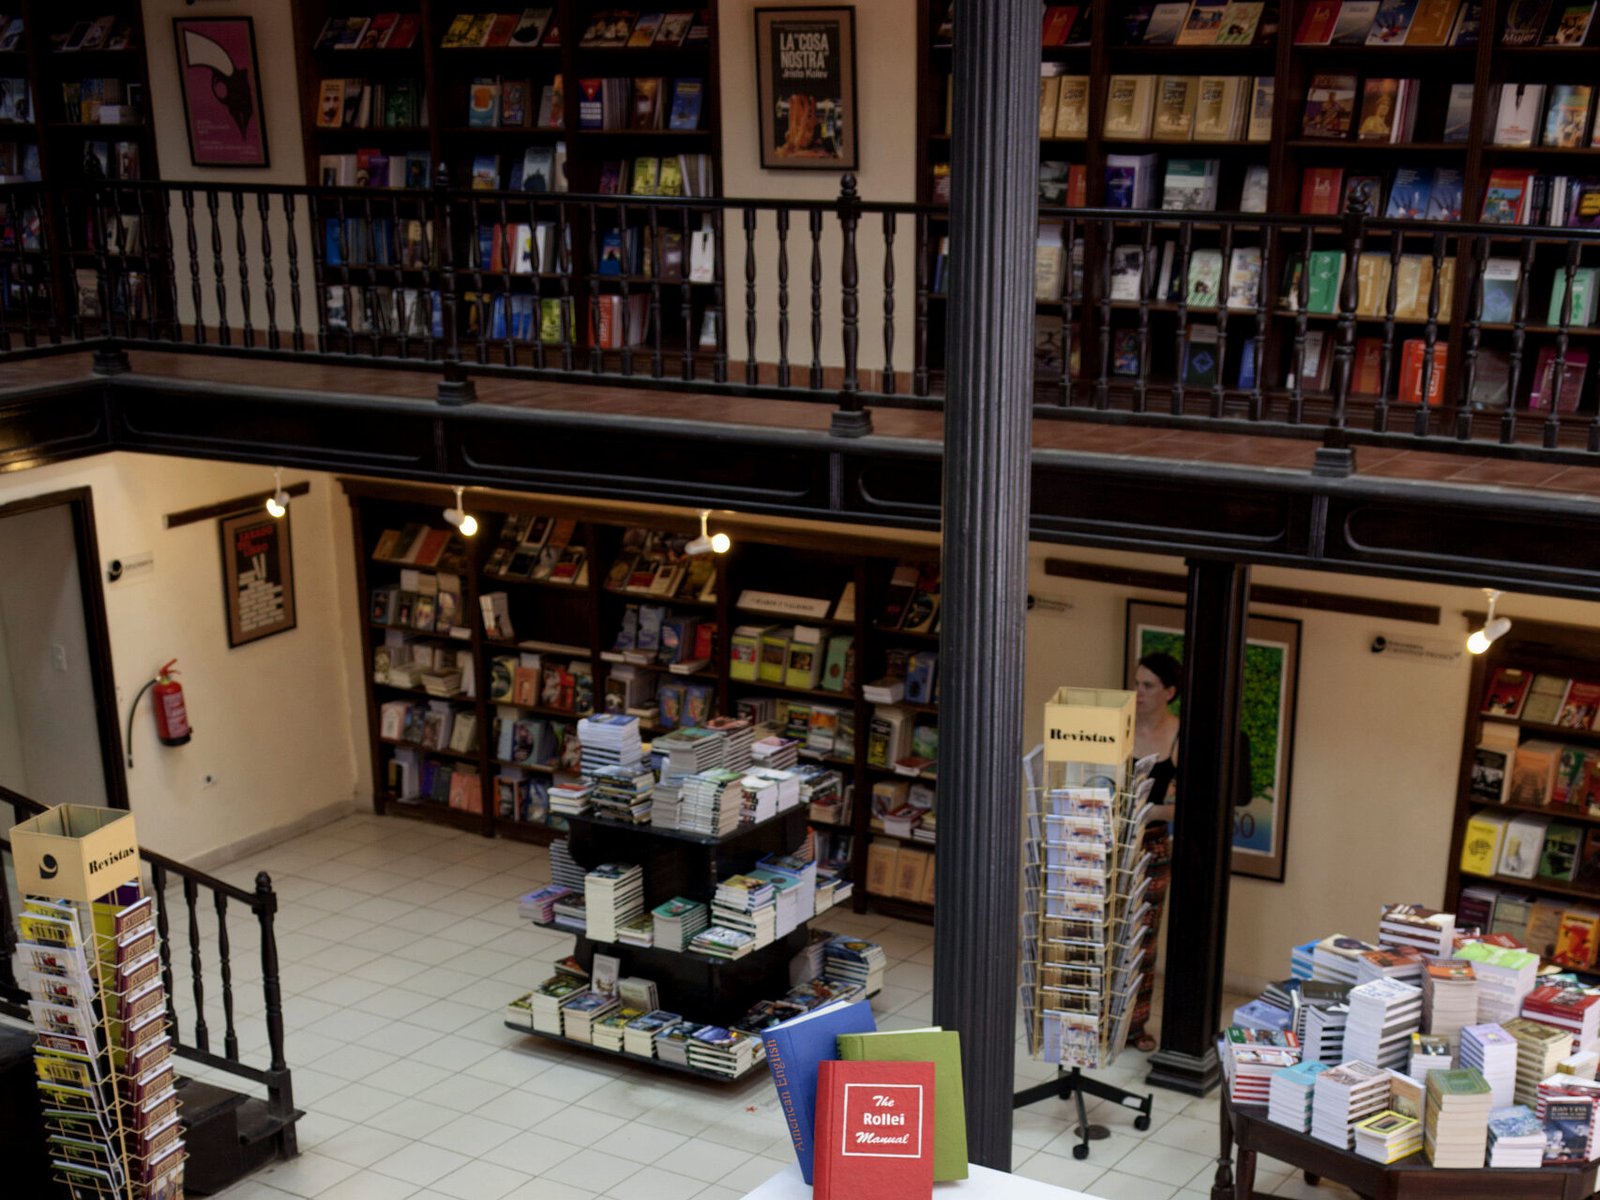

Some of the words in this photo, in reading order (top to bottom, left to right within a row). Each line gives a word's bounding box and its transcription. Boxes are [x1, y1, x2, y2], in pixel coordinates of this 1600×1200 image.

[780, 32, 795, 51] LA
[1050, 728, 1116, 745] Revistas
[89, 847, 135, 875] Revistas
[766, 1038, 789, 1087] English
[872, 1094, 895, 1108] The
[781, 1089, 805, 1152] American
[863, 1111, 905, 1126] Rollei
[855, 1131, 910, 1145] Manual
